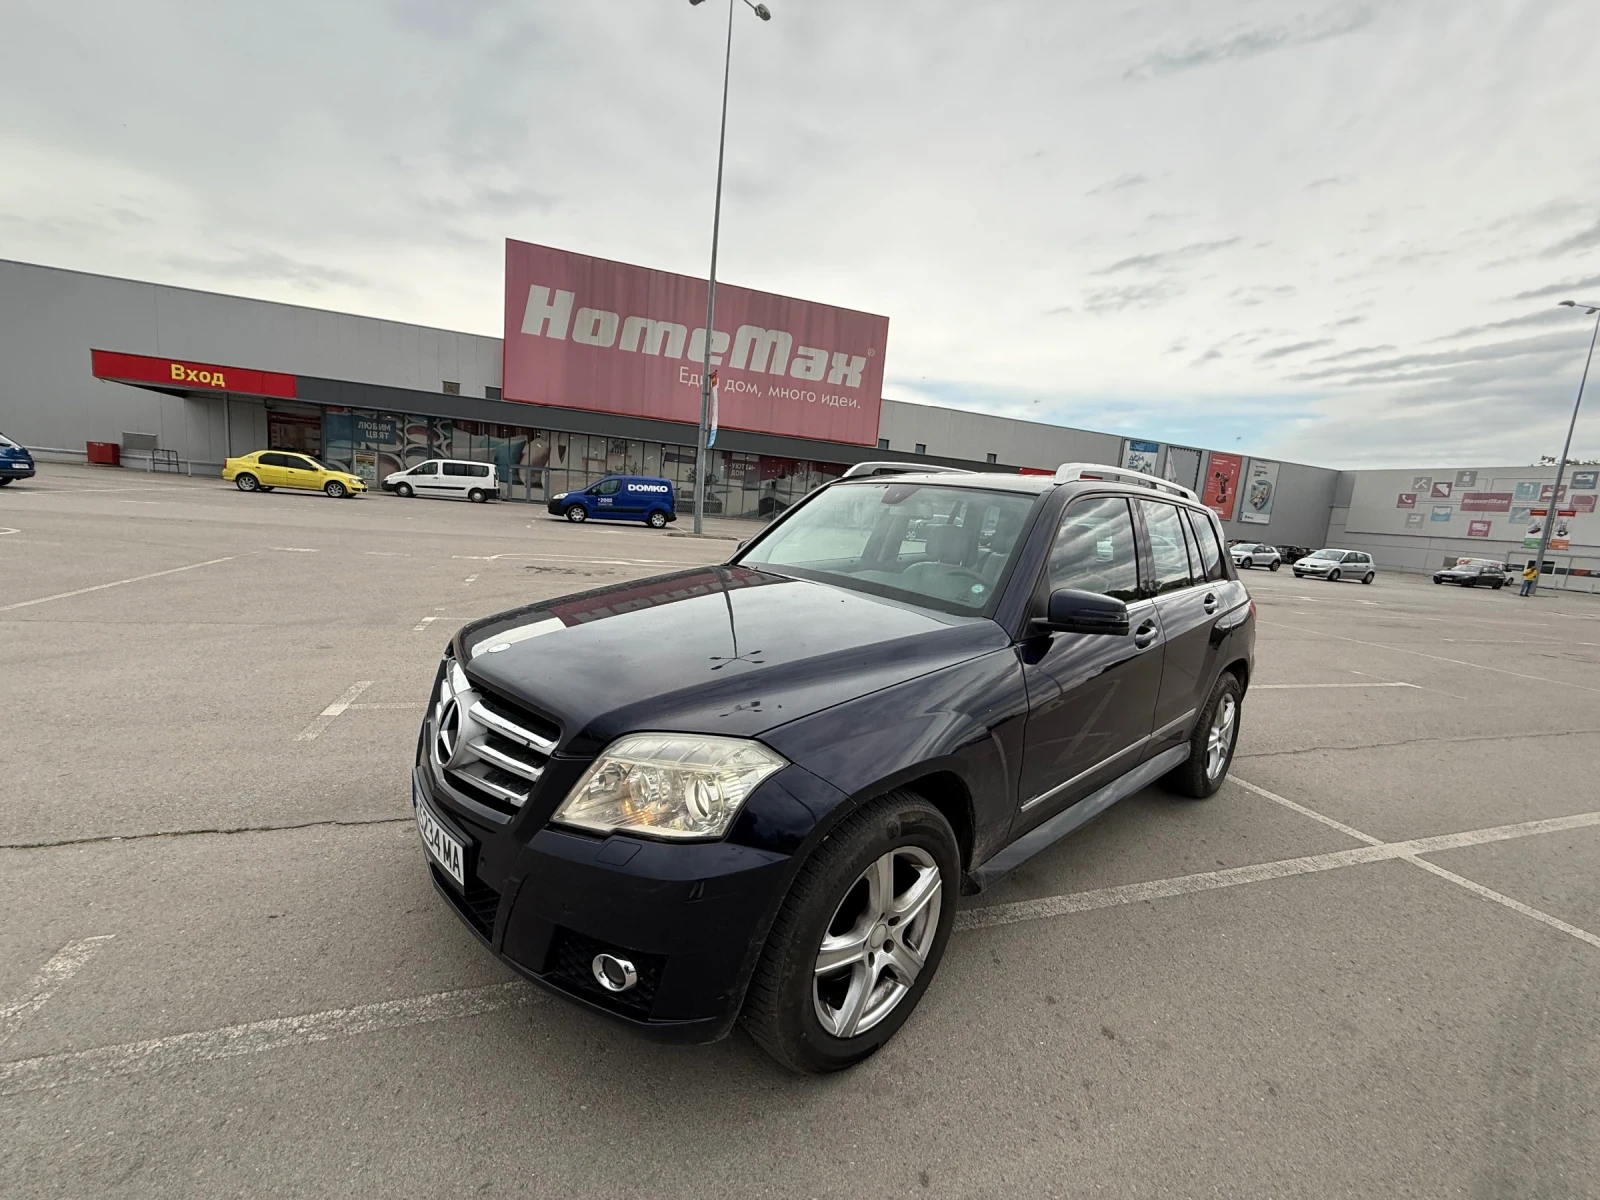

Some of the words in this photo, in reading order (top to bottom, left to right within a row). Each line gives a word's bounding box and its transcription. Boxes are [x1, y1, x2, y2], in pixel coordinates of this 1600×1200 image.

[520, 284, 867, 388] HomeMax
[171, 363, 226, 388] Вход
[724, 379, 762, 397] дом,
[768, 387, 816, 403] много
[821, 393, 861, 409] идеи.
[357, 421, 391, 432] ЛЮБИМ
[365, 431, 390, 440] ЦВЯТ
[627, 484, 669, 493] DOMKO
[442, 833, 462, 879] MA
